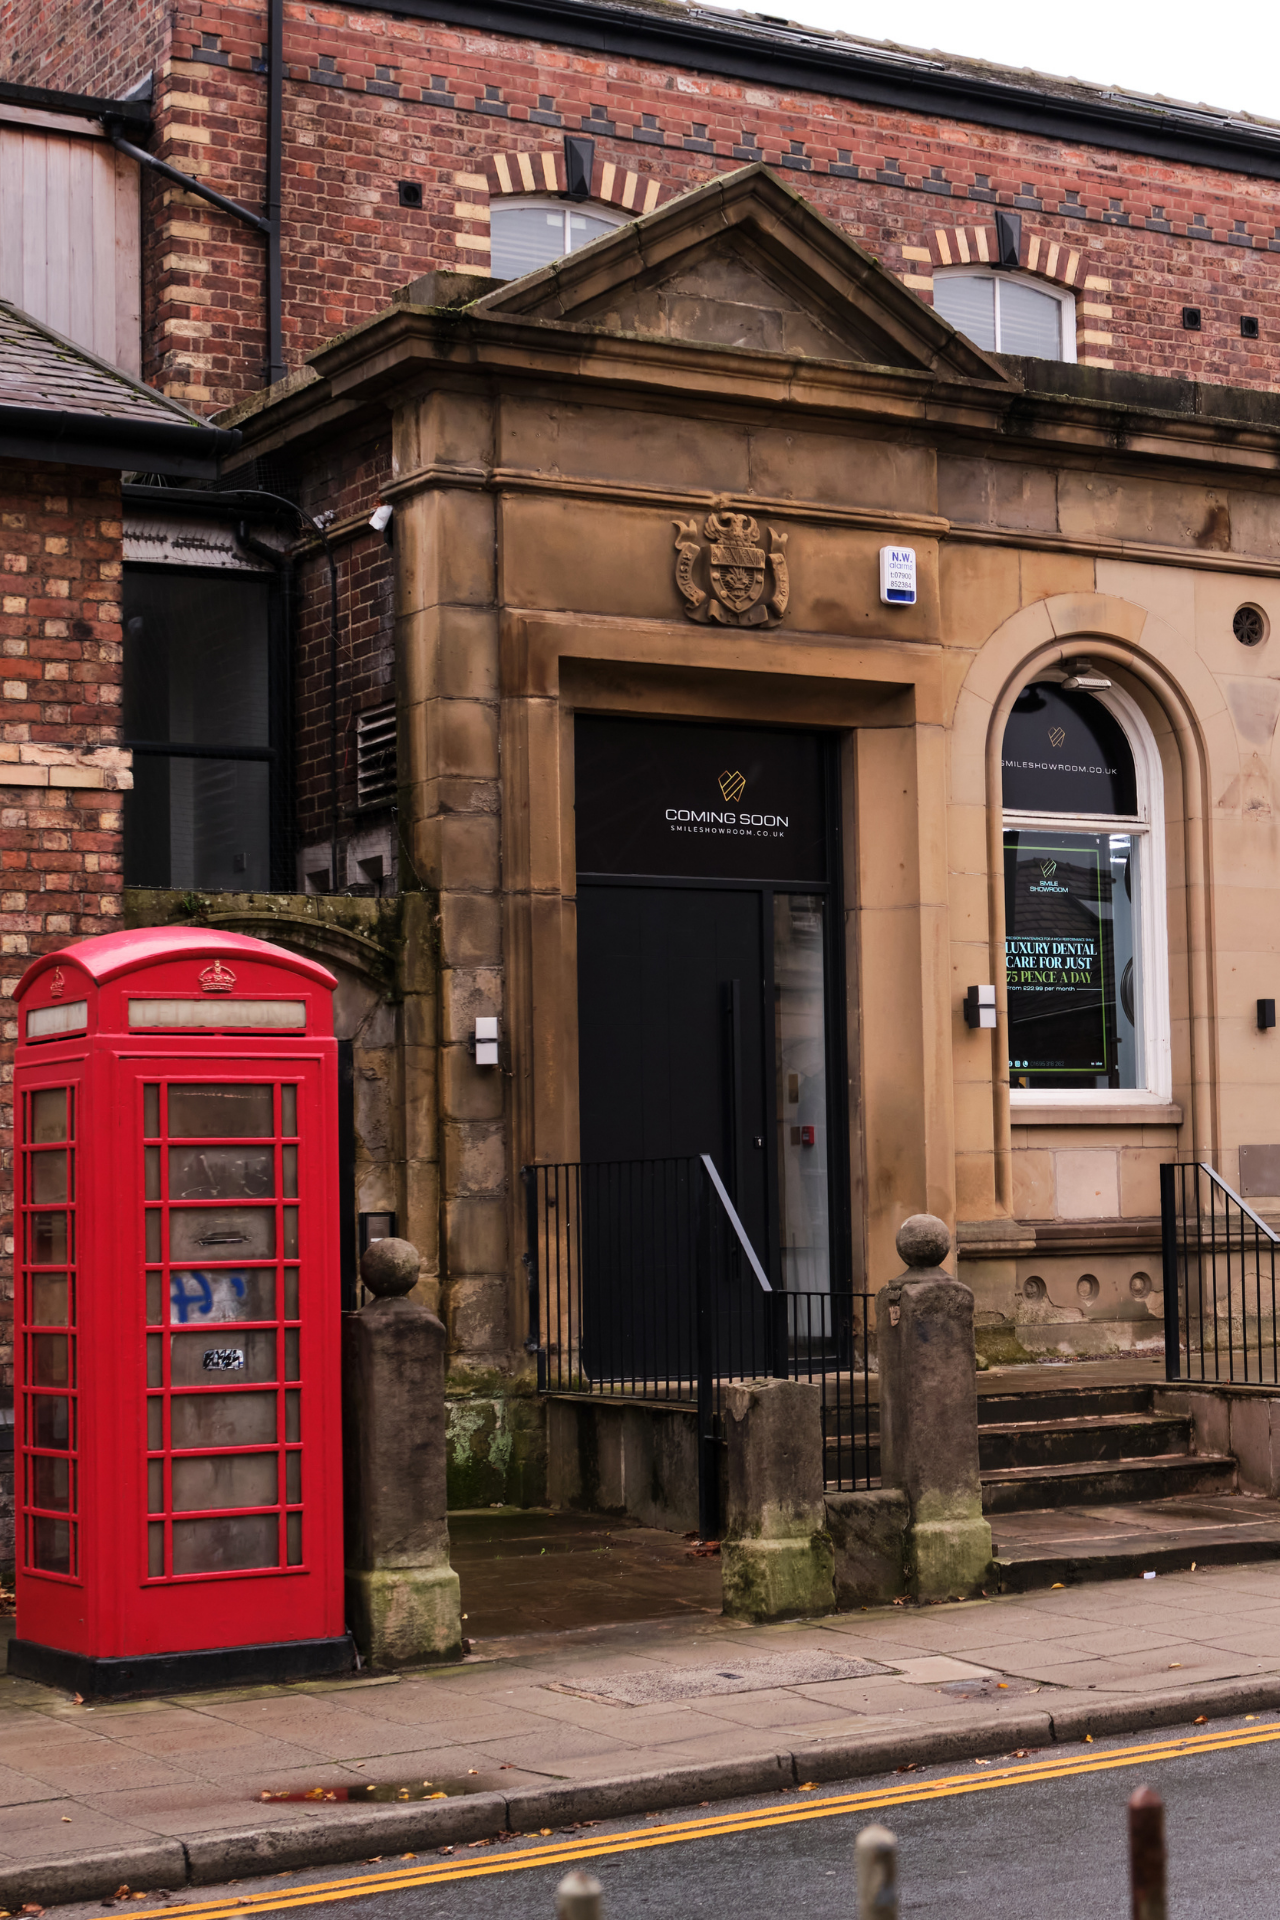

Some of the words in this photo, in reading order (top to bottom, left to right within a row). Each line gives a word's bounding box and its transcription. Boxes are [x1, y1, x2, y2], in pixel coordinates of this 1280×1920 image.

[892, 552, 913, 563] N.W.
[889, 562, 913, 570] alarms
[665, 809, 736, 824] COMING
[739, 813, 789, 827] SOON
[670, 825, 785, 838] SMILESHOWROOM.CO.UK
[1005, 942, 1050, 954] LUXURY
[1052, 943, 1097, 955] DENTAL
[1006, 956, 1037, 968] CARE
[1039, 957, 1062, 969] FOR
[1064, 957, 1092, 969] JUST
[1006, 971, 1018, 983] 75
[1020, 971, 1057, 983] PENCE
[1060, 971, 1068, 983] A
[1070, 971, 1093, 983] DAY
